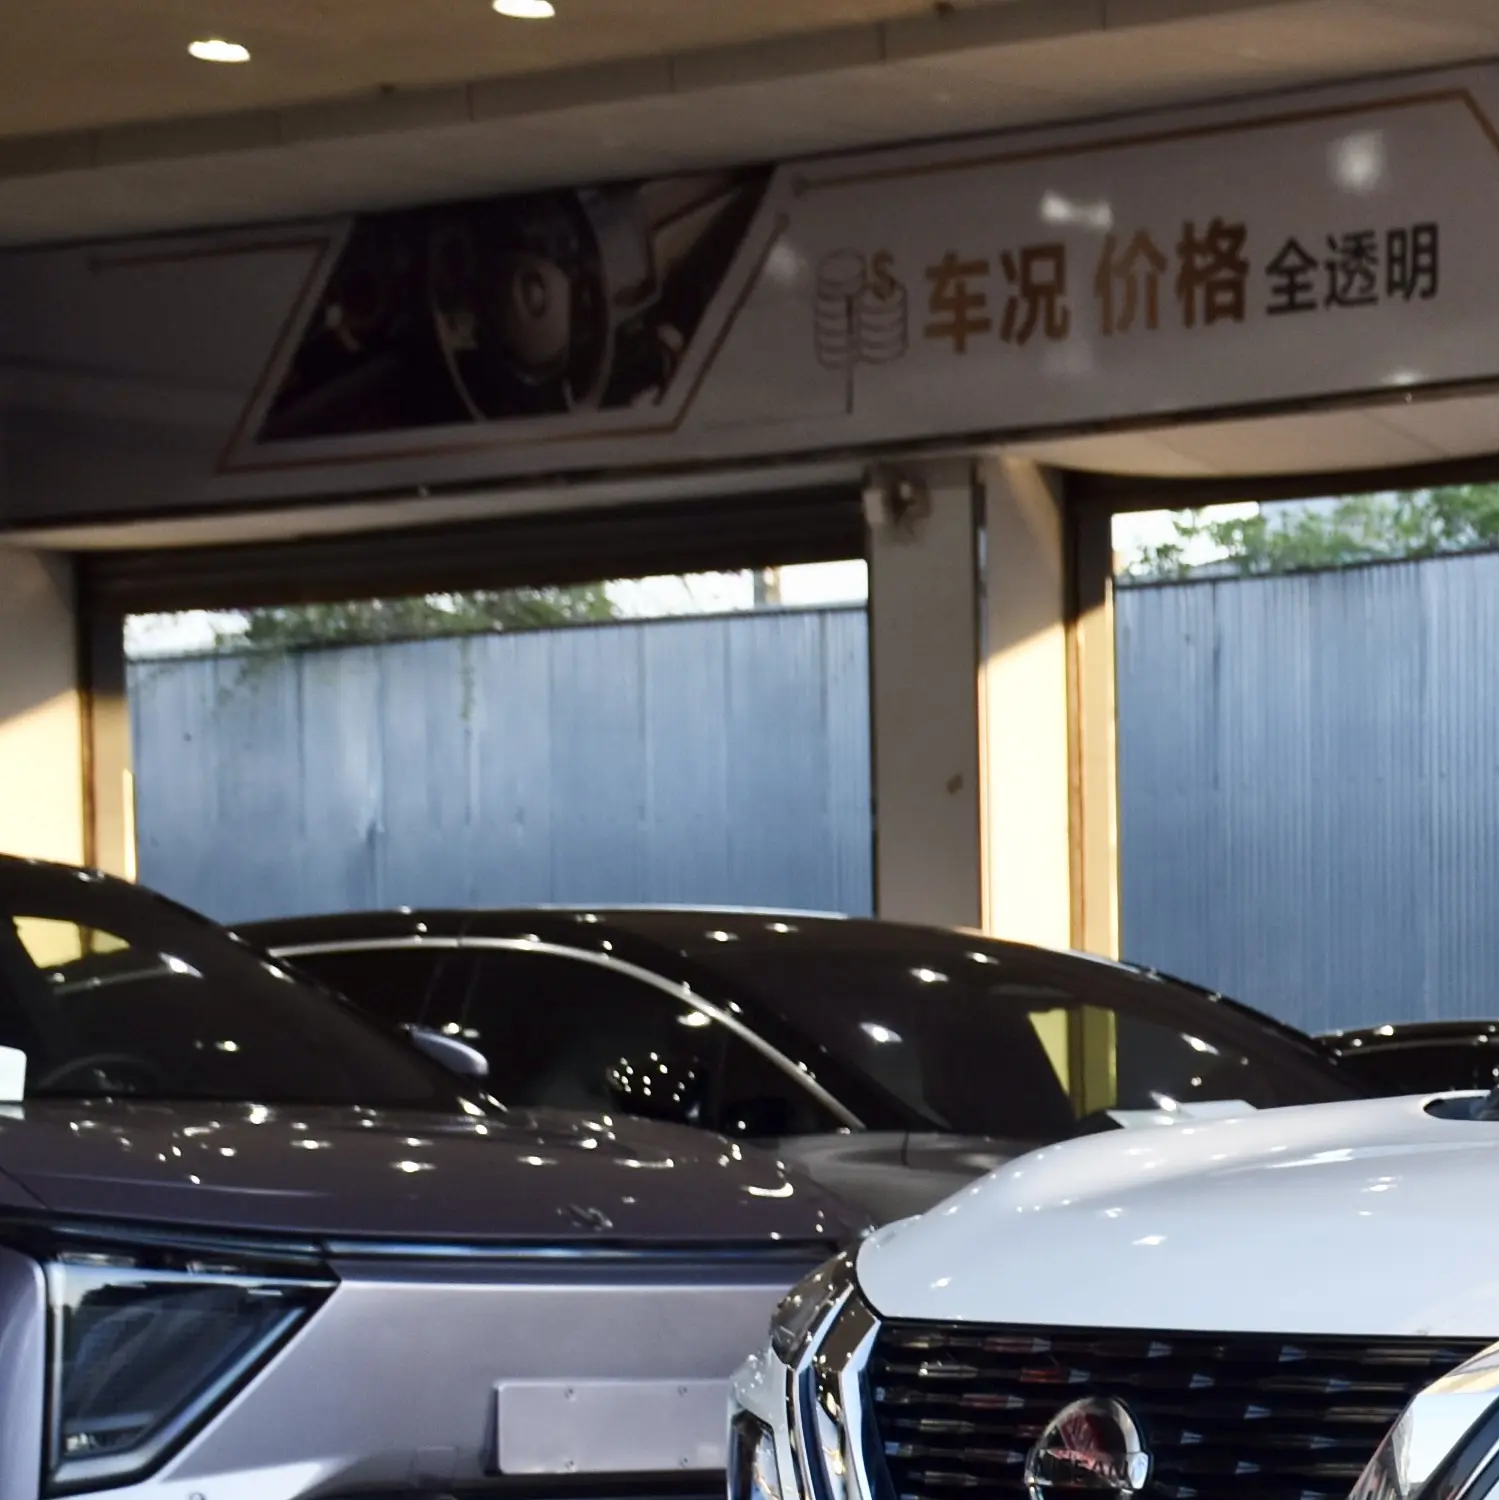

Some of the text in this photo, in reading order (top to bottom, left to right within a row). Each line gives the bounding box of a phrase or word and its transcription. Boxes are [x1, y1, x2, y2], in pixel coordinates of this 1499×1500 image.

[924, 217, 1439, 354] 车况 价格 全透明
[1034, 1456, 1129, 1484] NSAN
